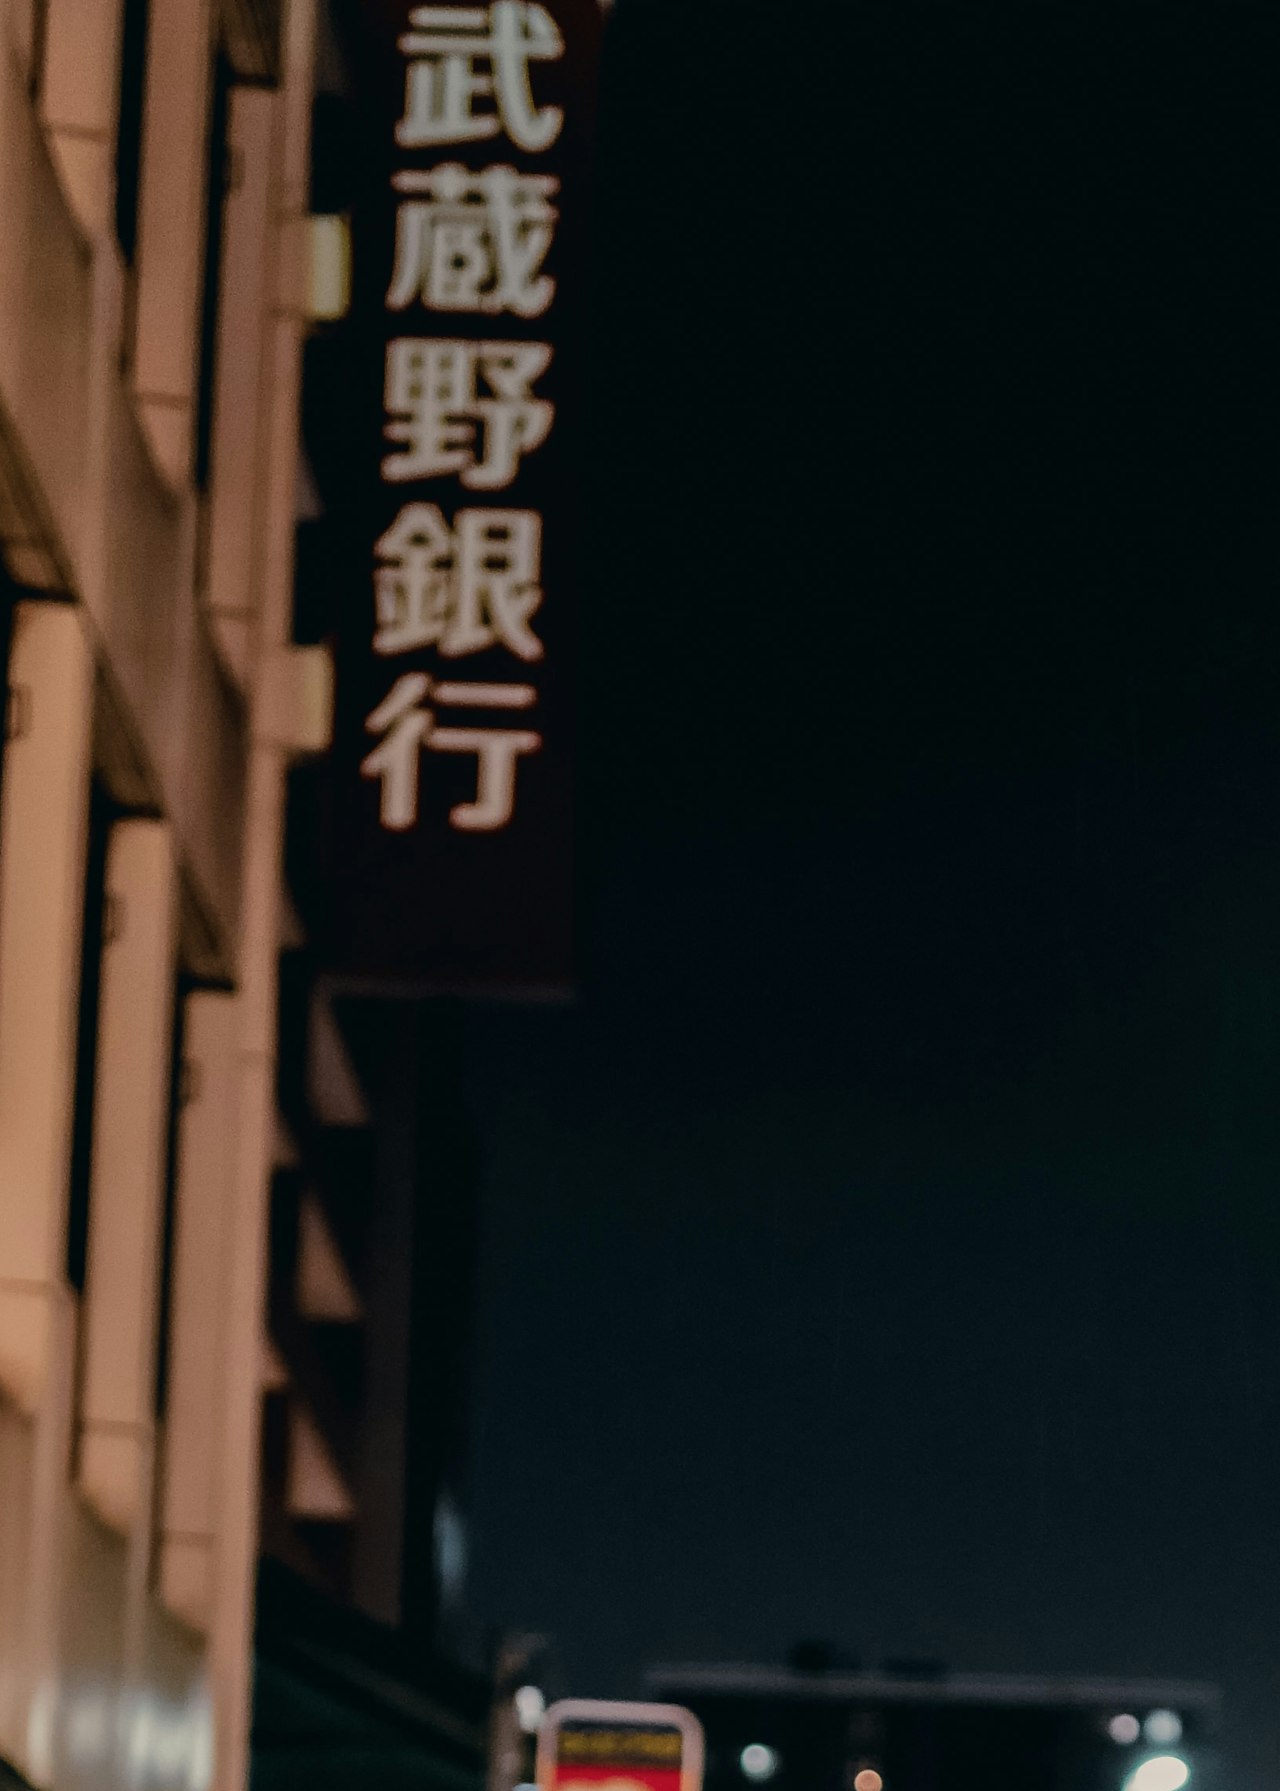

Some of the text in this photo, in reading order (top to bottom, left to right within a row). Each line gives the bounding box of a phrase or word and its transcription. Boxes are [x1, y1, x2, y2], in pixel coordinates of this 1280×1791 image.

[360, 0, 564, 832] 武蔵野銀行
